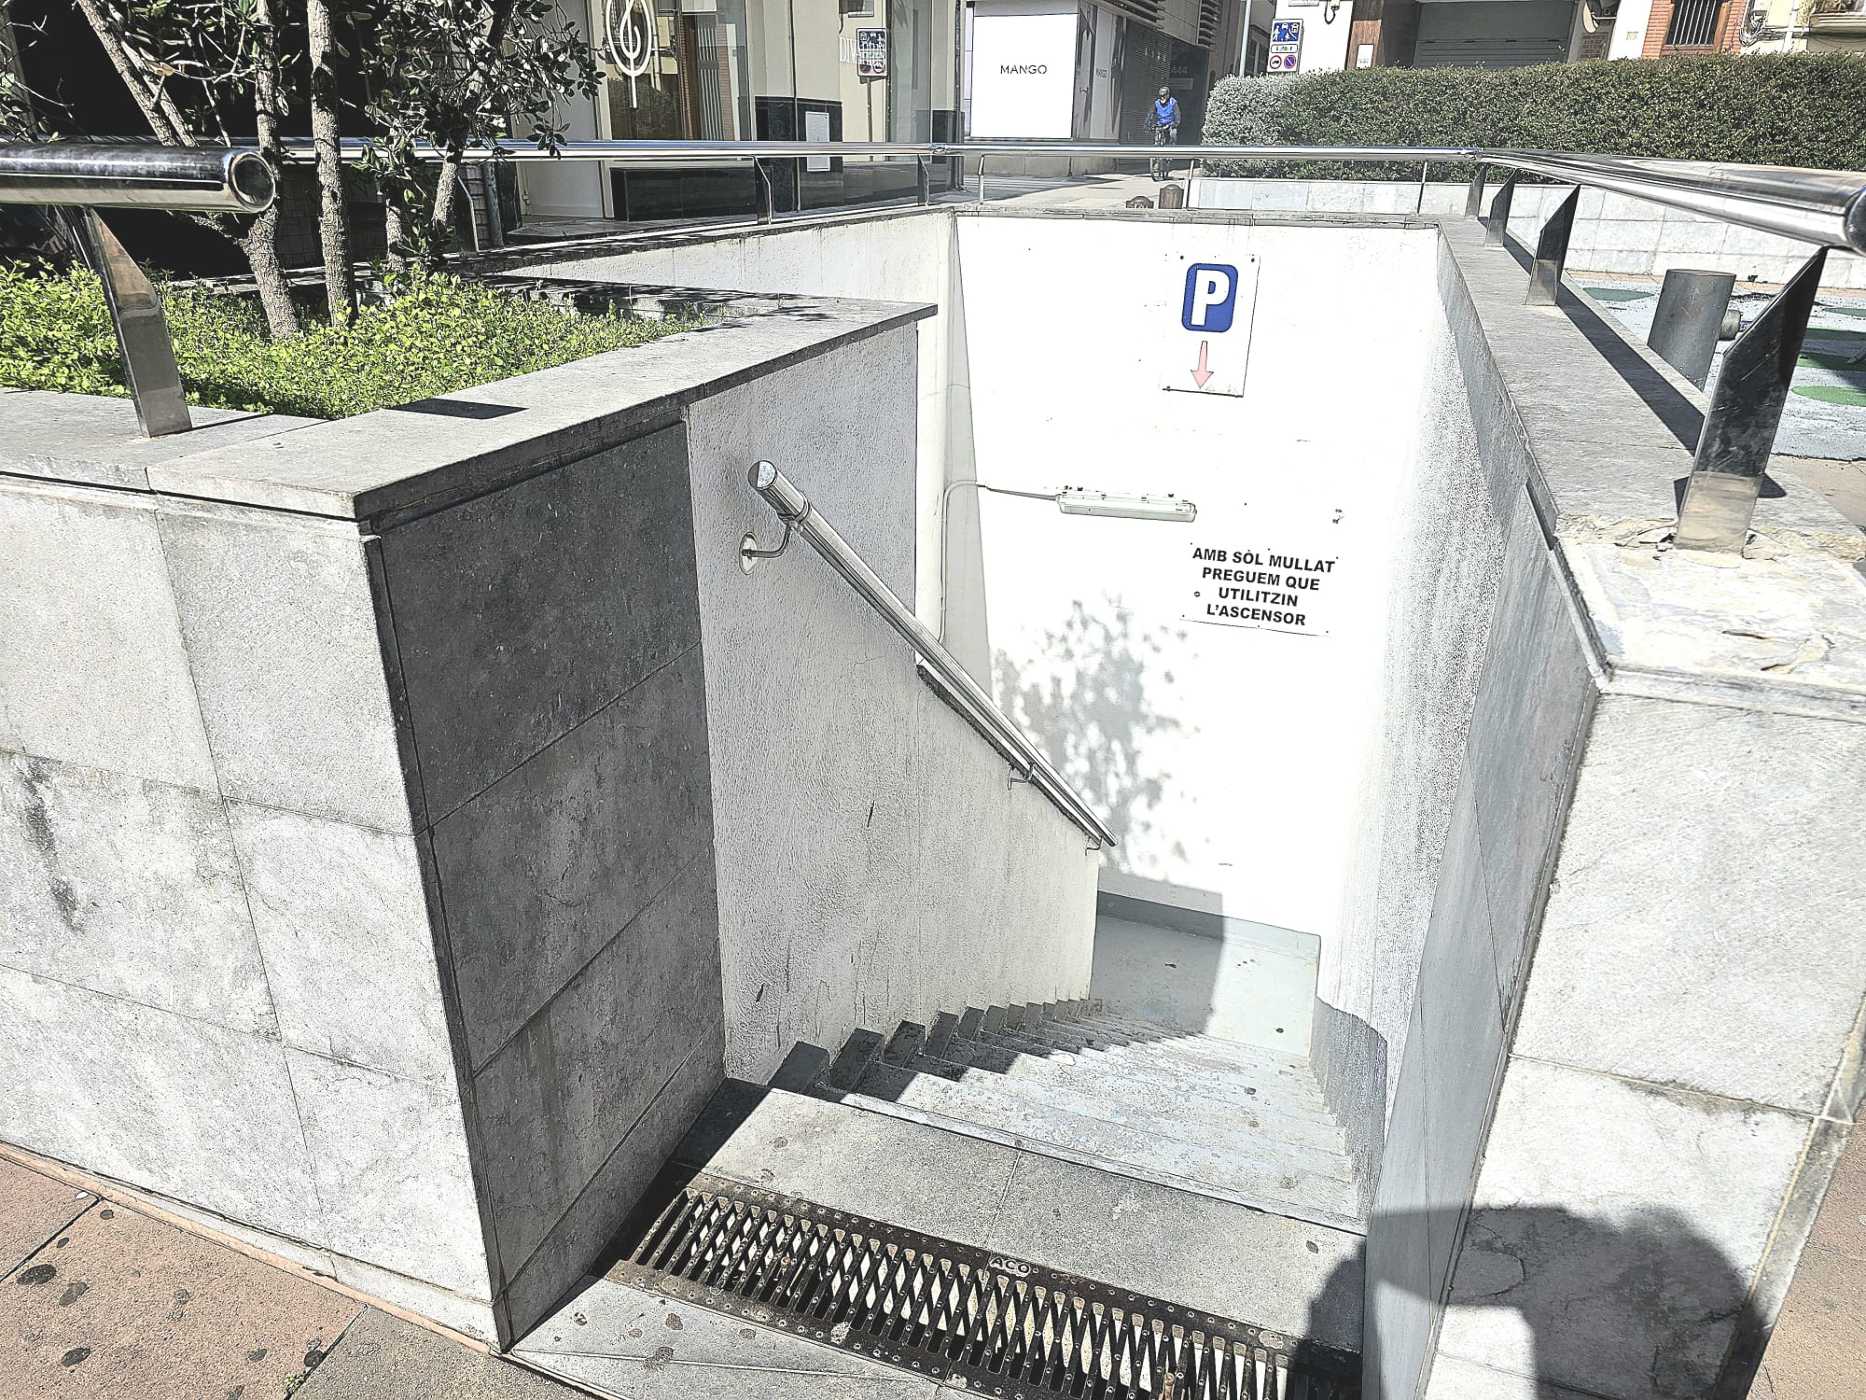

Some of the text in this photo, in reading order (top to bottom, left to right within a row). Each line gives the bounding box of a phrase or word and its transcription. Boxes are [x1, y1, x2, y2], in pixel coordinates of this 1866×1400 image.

[1000, 64, 1048, 75] MANGO
[1191, 269, 1230, 326] P
[1192, 547, 1227, 562] AMB
[1269, 554, 1335, 573] MULLAT
[1202, 567, 1320, 590] PREGUEM QUE
[1218, 587, 1298, 607] UTILITZIN
[1206, 603, 1306, 626] L'ASCENSOR
[990, 1256, 1031, 1275] ACO
